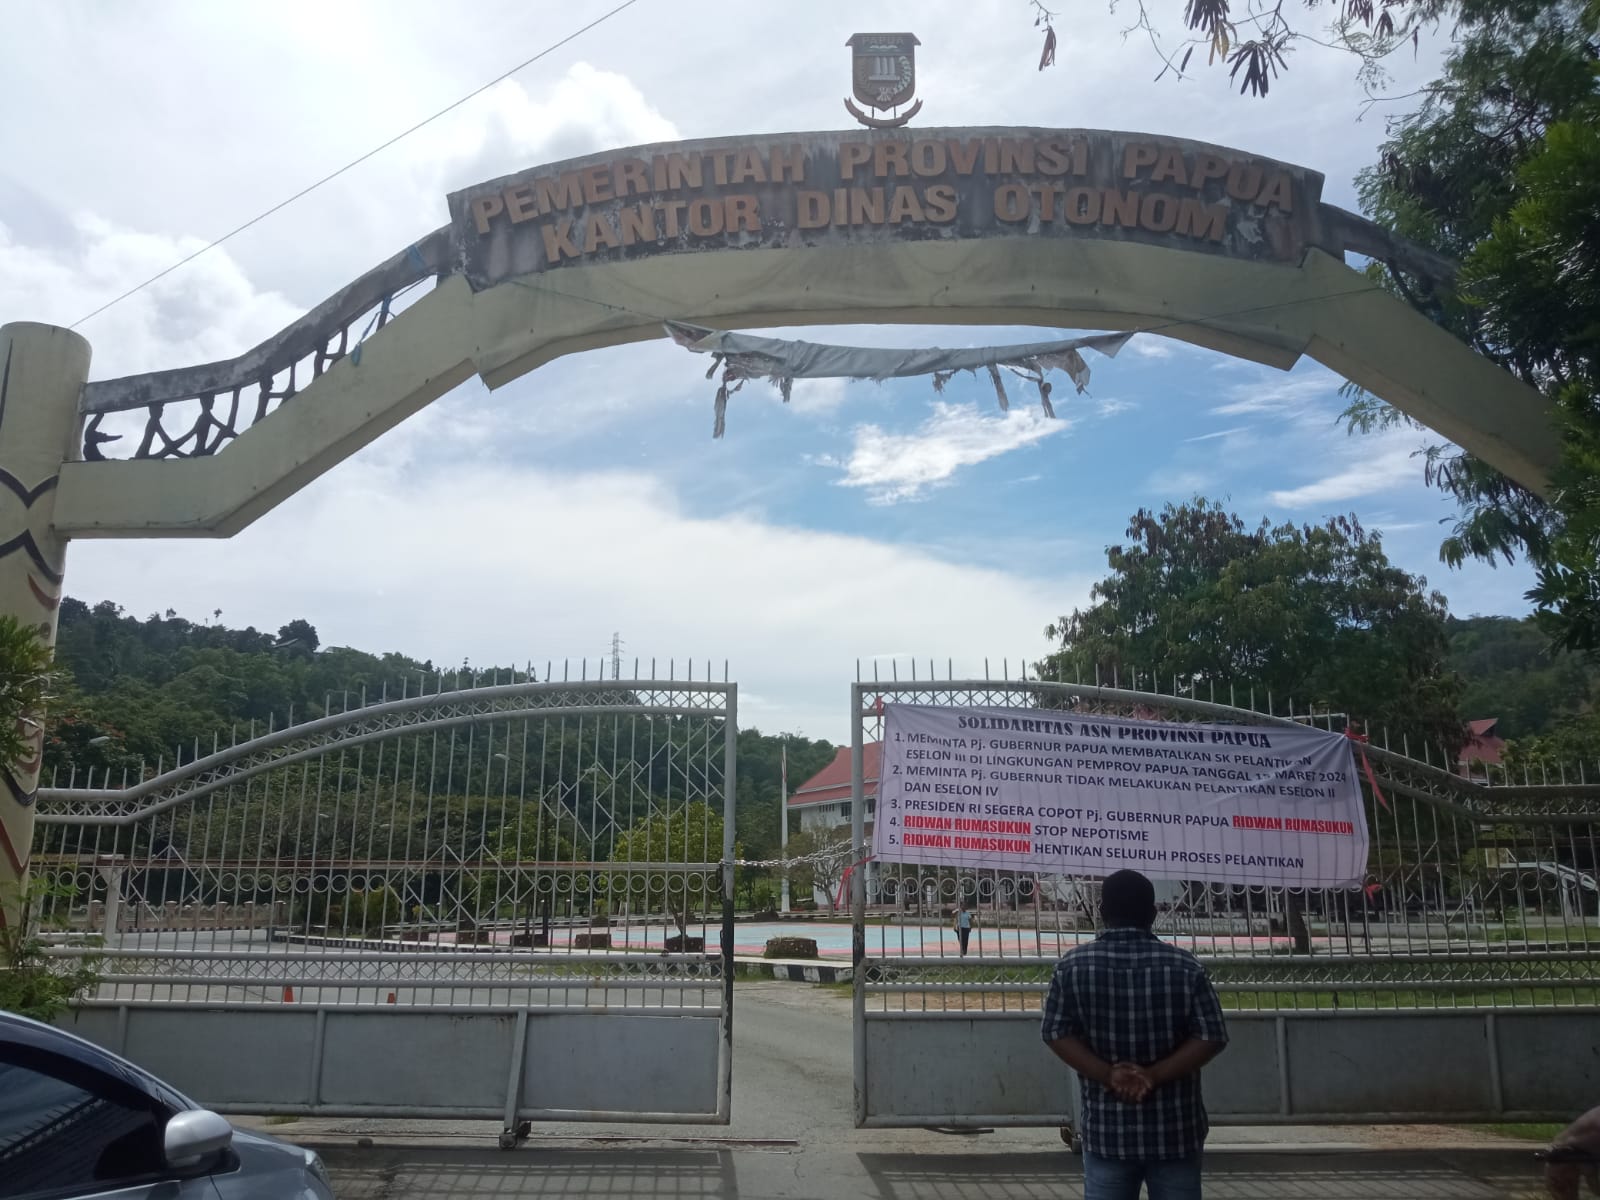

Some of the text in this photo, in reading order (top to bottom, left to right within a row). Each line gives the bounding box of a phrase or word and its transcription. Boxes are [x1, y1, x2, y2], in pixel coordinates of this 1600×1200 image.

[471, 137, 1293, 235] PEMERINTAH PROVINSI PAPUA
[541, 184, 1229, 264] KANTOR DINAS OTONOM
[895, 733, 905, 743] 1.
[907, 732, 967, 749] MEMINTA
[970, 738, 986, 751] Pj.
[990, 739, 1062, 752] GUBERNUR
[1065, 743, 1108, 755] PAPUA
[1112, 746, 1212, 762] MEMBATALKAN
[1215, 752, 1230, 764] SK
[958, 716, 1272, 748] SOLIDARITAS ASN PROVINSI PAPUA
[892, 765, 1335, 798] 2. MEMINTA Pj. GUBERNUR TIDAK MELAKUKAN PELANTIKAN ESELON II
[906, 750, 951, 761] ESELON
[955, 754, 966, 762] III
[970, 754, 982, 764] DI
[986, 755, 1073, 768] LINGKUNGAN
[1077, 759, 1141, 772] PEMPROV
[1145, 764, 1189, 776] PAPUA
[1192, 766, 1252, 781] TANGGAL
[1274, 770, 1316, 782] MARET
[1319, 772, 1346, 783] 2024
[904, 782, 998, 796] DAN ESELON IV
[890, 800, 1354, 834] 3. PRESIDEN RI SEGERA COPOT Pj. GUBERNUR PAPUA RIDWAN RUMASUKUN
[890, 815, 1149, 841] 4. RIDWAN RUMASUKUN STOP NEPOTISME
[888, 833, 1304, 868] 5. RIDWAN RUMASUKUN HENTIKAN SELURUH PROSES PELANTIKAN
